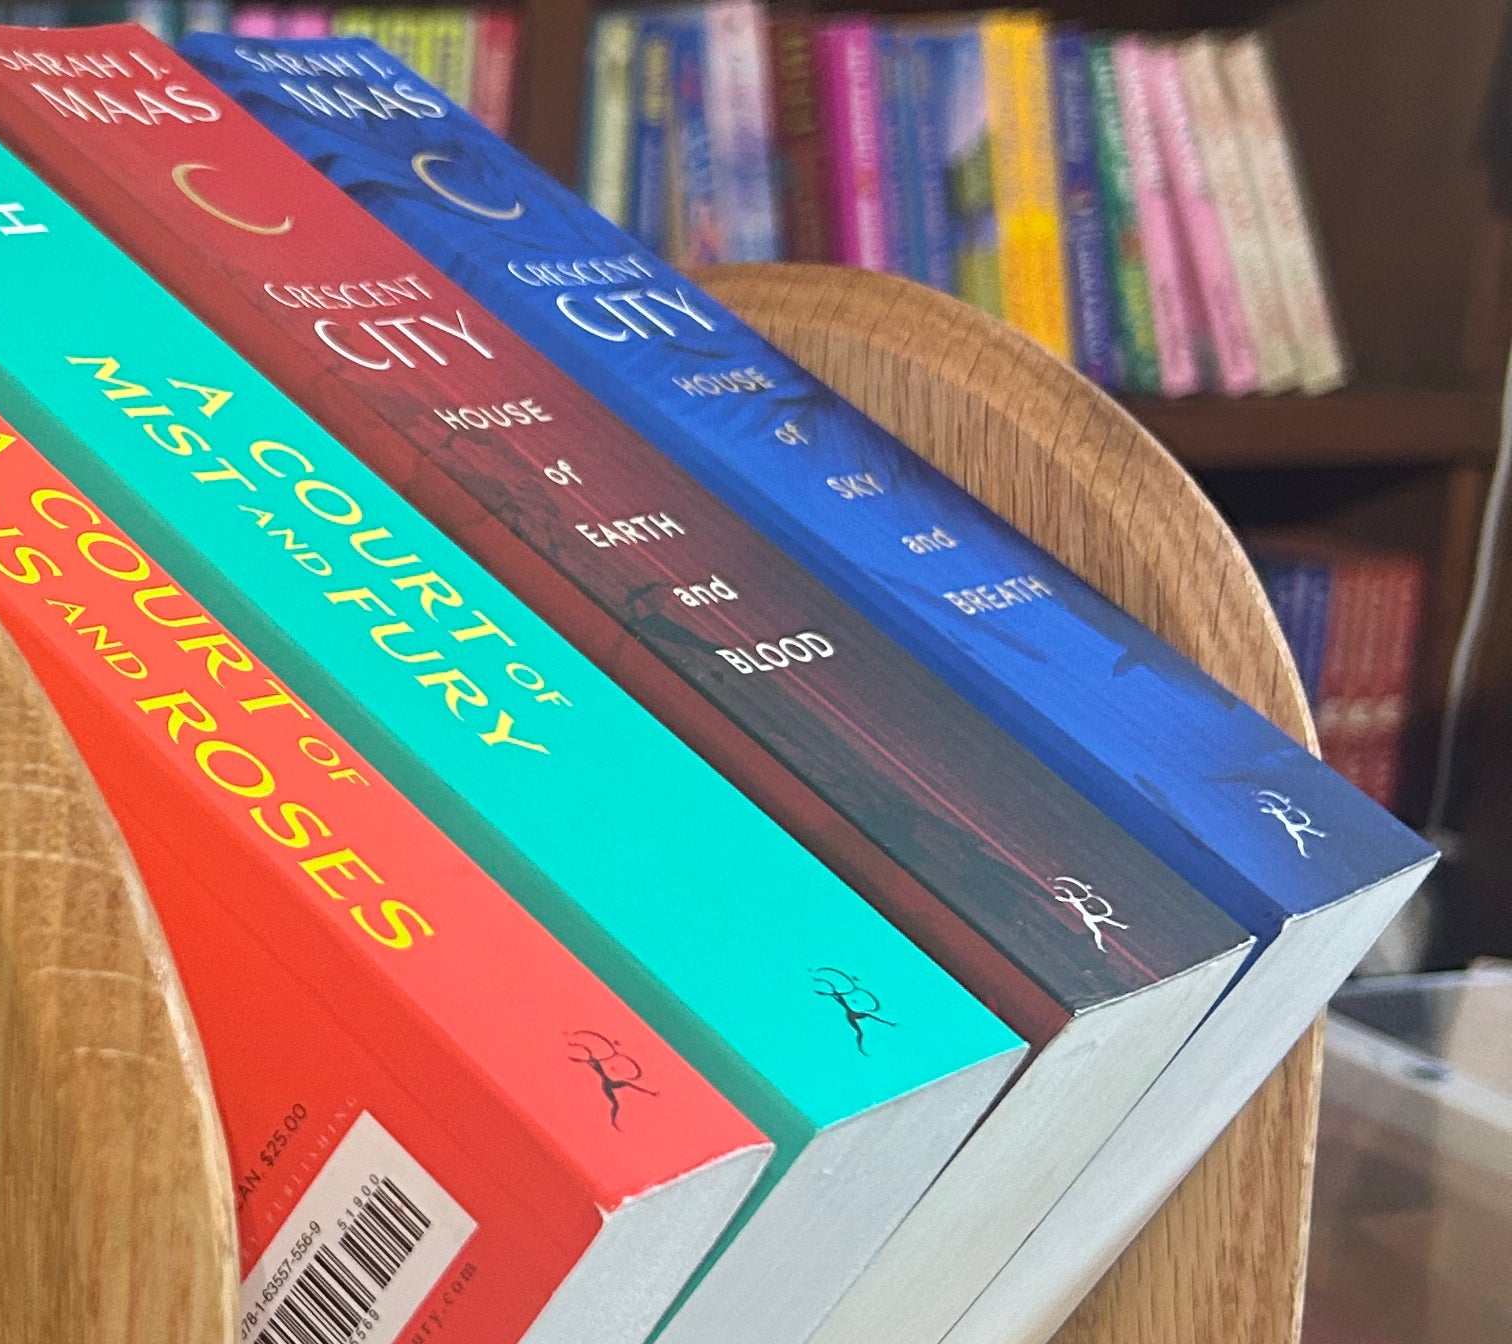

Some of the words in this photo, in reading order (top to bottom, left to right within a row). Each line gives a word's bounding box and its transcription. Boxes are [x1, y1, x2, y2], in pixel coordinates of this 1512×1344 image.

[128, 50, 170, 81] J.
[234, 46, 365, 77] SARAH
[361, 51, 397, 78] J.
[31, 81, 222, 126] MAAS
[278, 80, 449, 121] MAAS
[506, 256, 656, 287] CRESCENT
[264, 275, 434, 310] CRESCENT
[555, 287, 718, 344] CITY
[314, 308, 495, 371] CITY
[672, 365, 776, 398] HOUSE
[433, 398, 553, 432] HOUSE
[774, 419, 810, 446] of
[543, 459, 583, 487] of
[826, 471, 885, 500] SKY
[167, 378, 235, 419] A
[250, 440, 517, 650] COURT
[504, 662, 574, 709] OF
[575, 512, 686, 550] EARTH
[901, 525, 960, 555] and
[64, 355, 258, 493] MIST
[237, 504, 333, 578] AND
[325, 586, 552, 756] FURY
[673, 575, 739, 608] and
[943, 574, 1054, 616] BREATH
[31, 488, 311, 720] COURT
[297, 736, 371, 787] OF
[715, 630, 835, 676] BLOOD
[46, 596, 148, 681] AND
[135, 689, 435, 951] ROSES
[260, 1102, 308, 1167] $25.00
